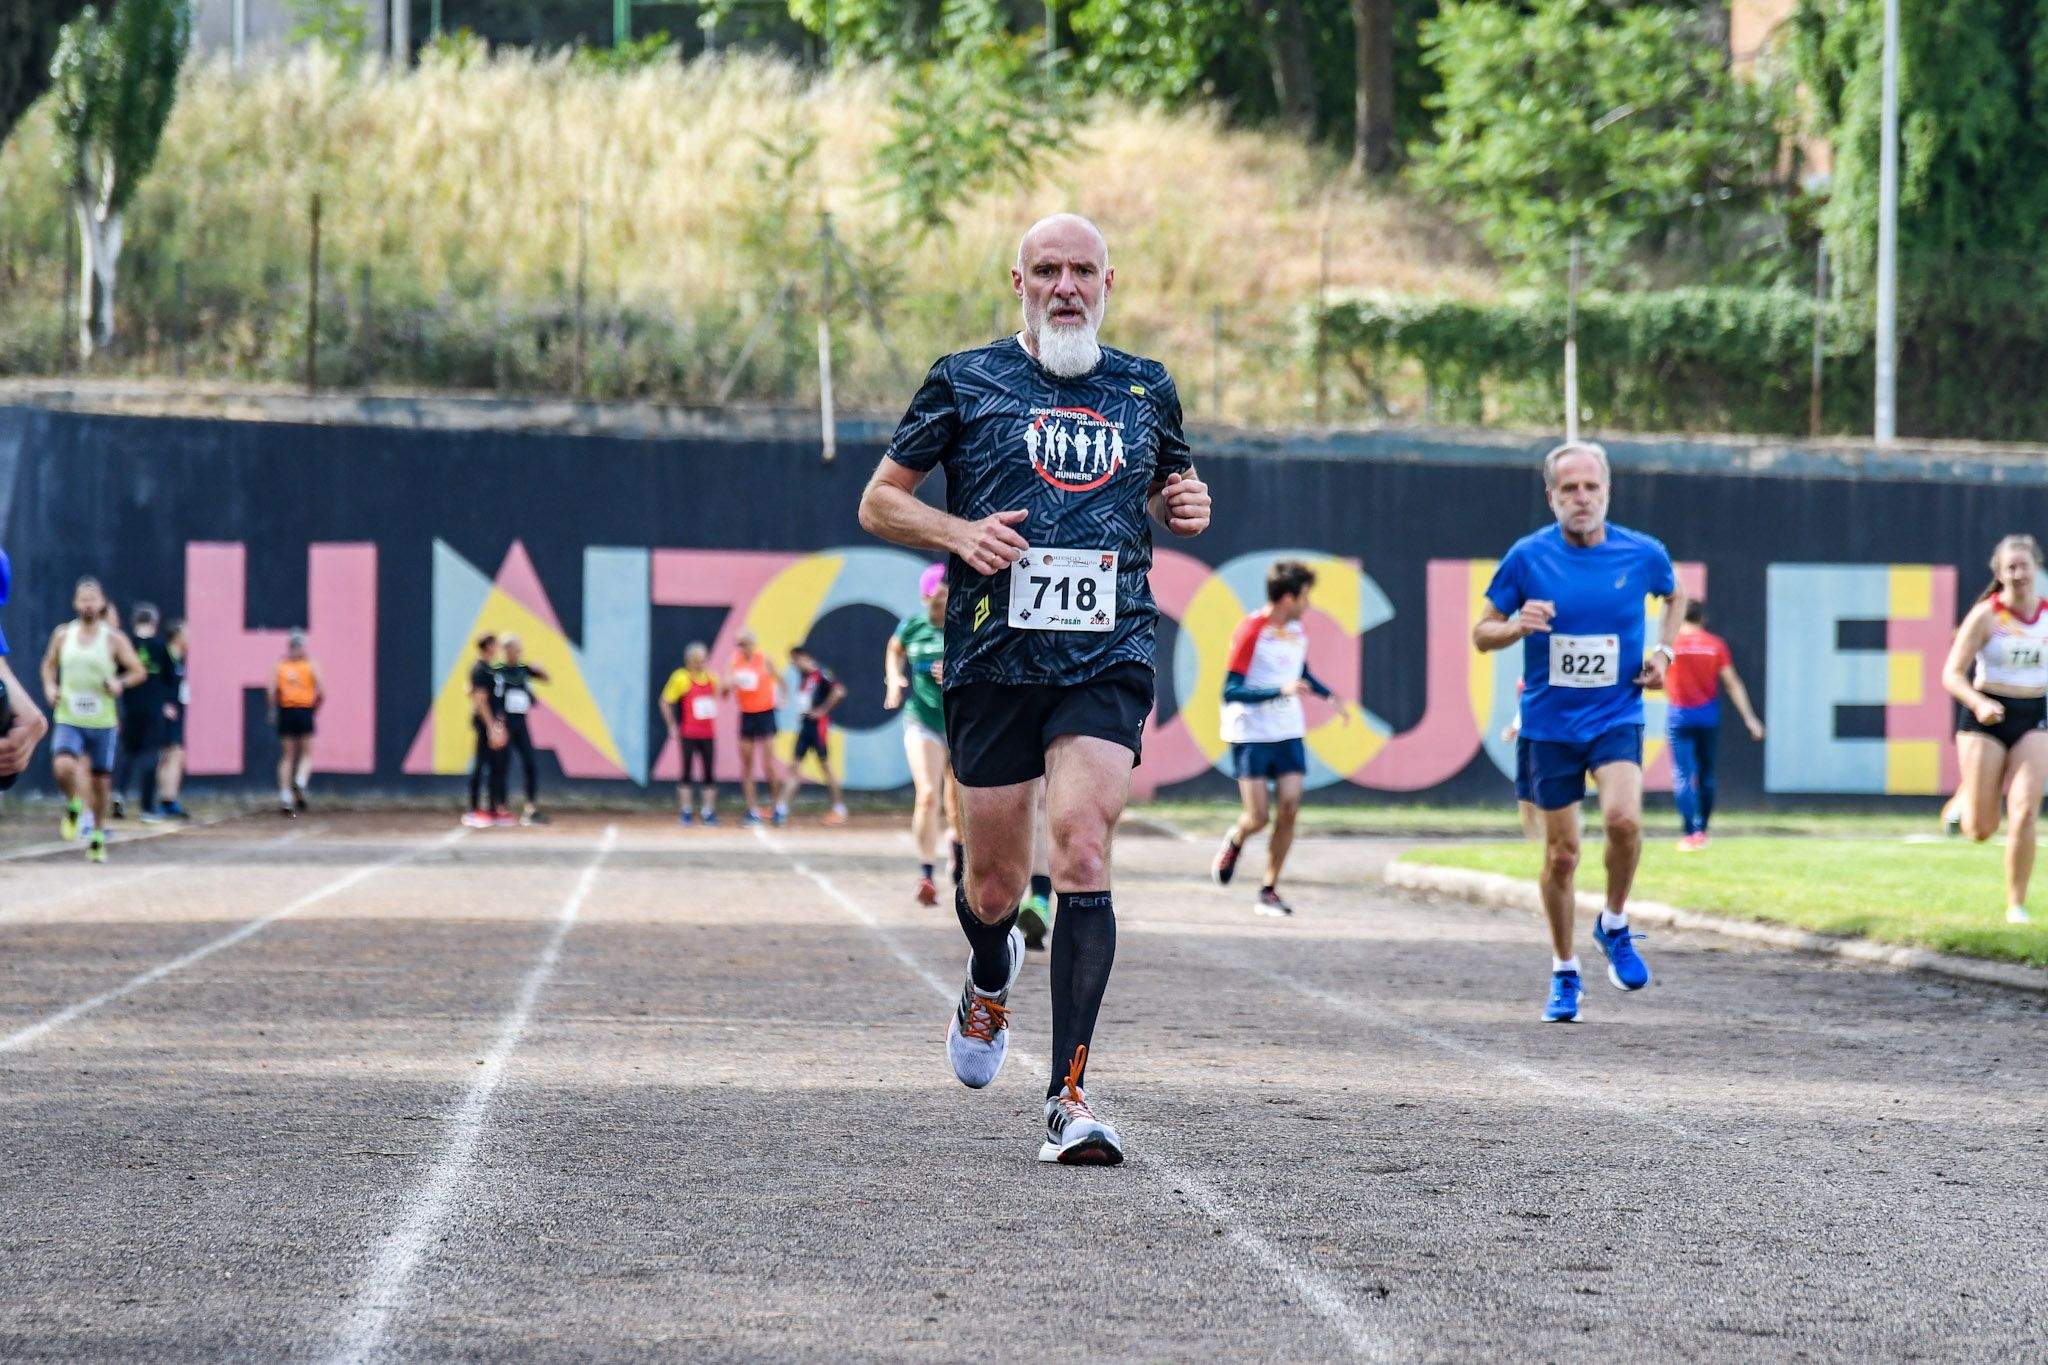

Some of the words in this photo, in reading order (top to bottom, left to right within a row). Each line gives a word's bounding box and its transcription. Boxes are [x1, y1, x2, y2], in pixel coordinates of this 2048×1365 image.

[1030, 408, 1088, 420] SOSPECHOSOS
[1077, 420, 1125, 430] HABITUALES
[1055, 471, 1092, 481] RUNNERS
[1030, 576, 1097, 611] 718
[1090, 617, 1110, 626] 2023
[1562, 654, 1605, 675] 822
